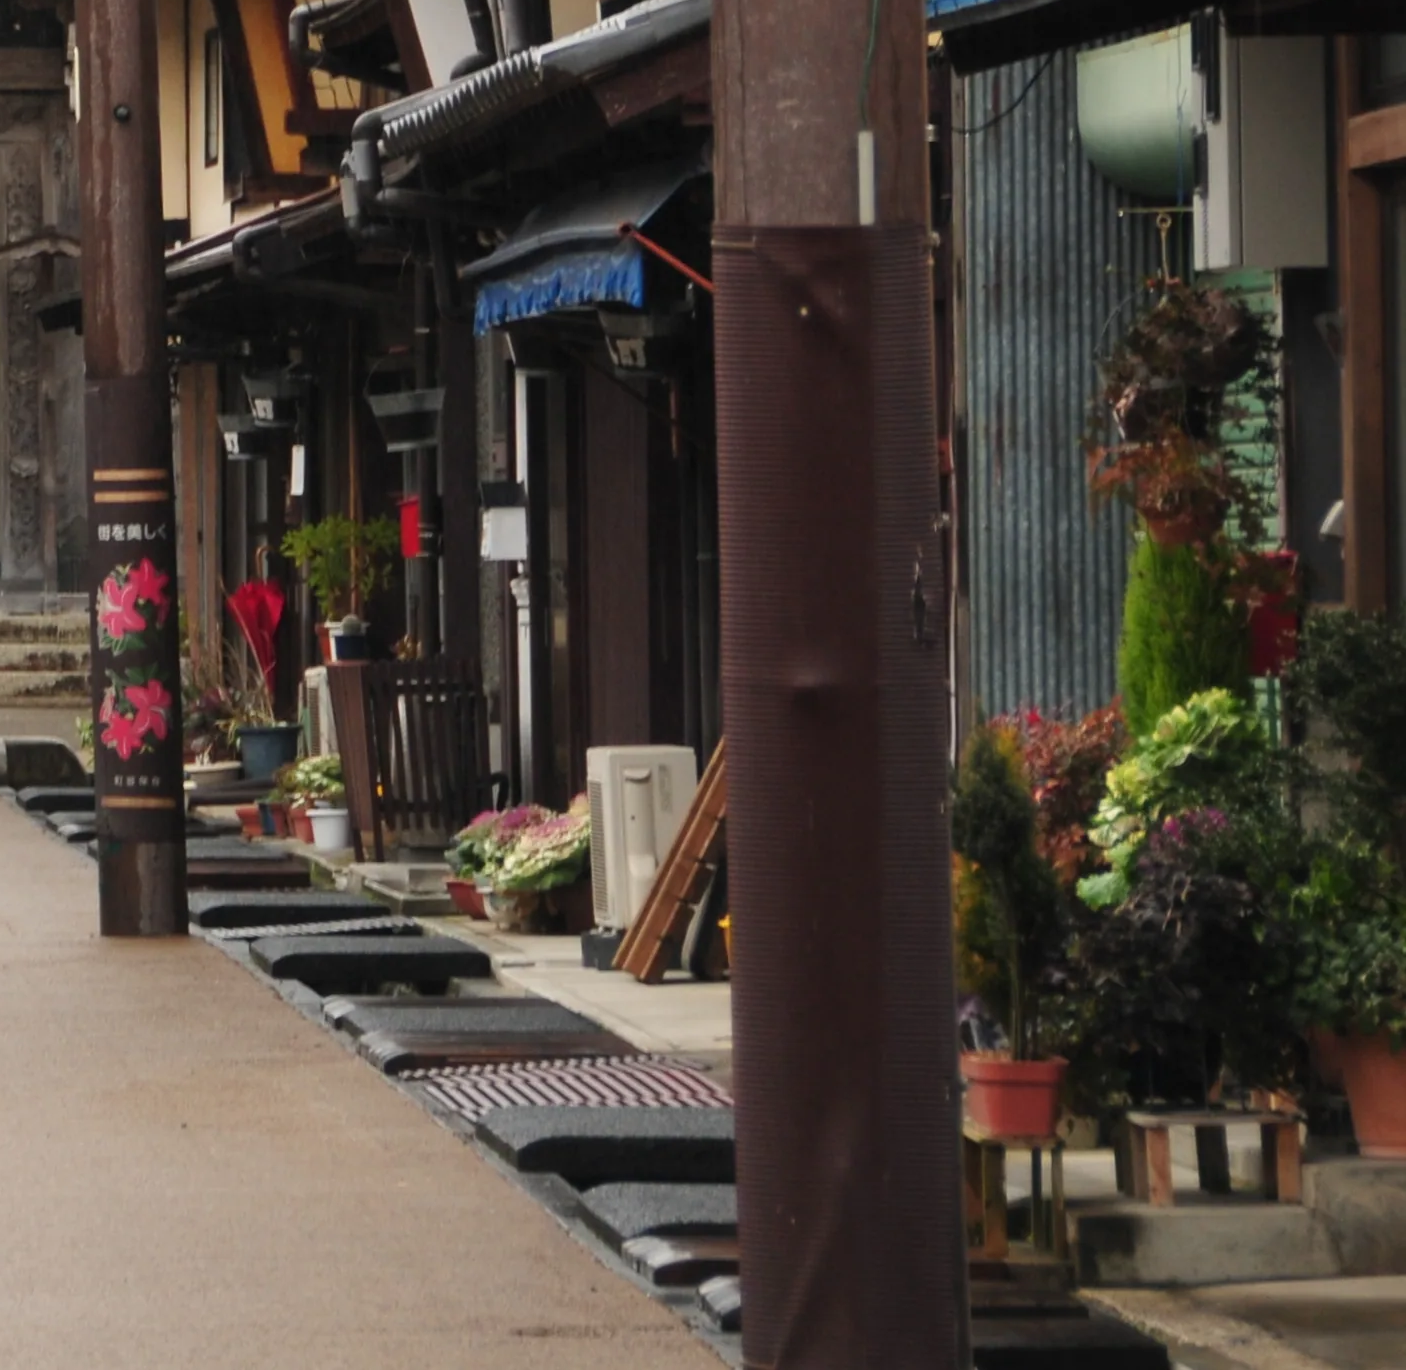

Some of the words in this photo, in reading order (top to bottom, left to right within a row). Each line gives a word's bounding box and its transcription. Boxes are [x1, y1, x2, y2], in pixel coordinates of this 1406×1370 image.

[97, 523, 167, 542] 街を美しく
